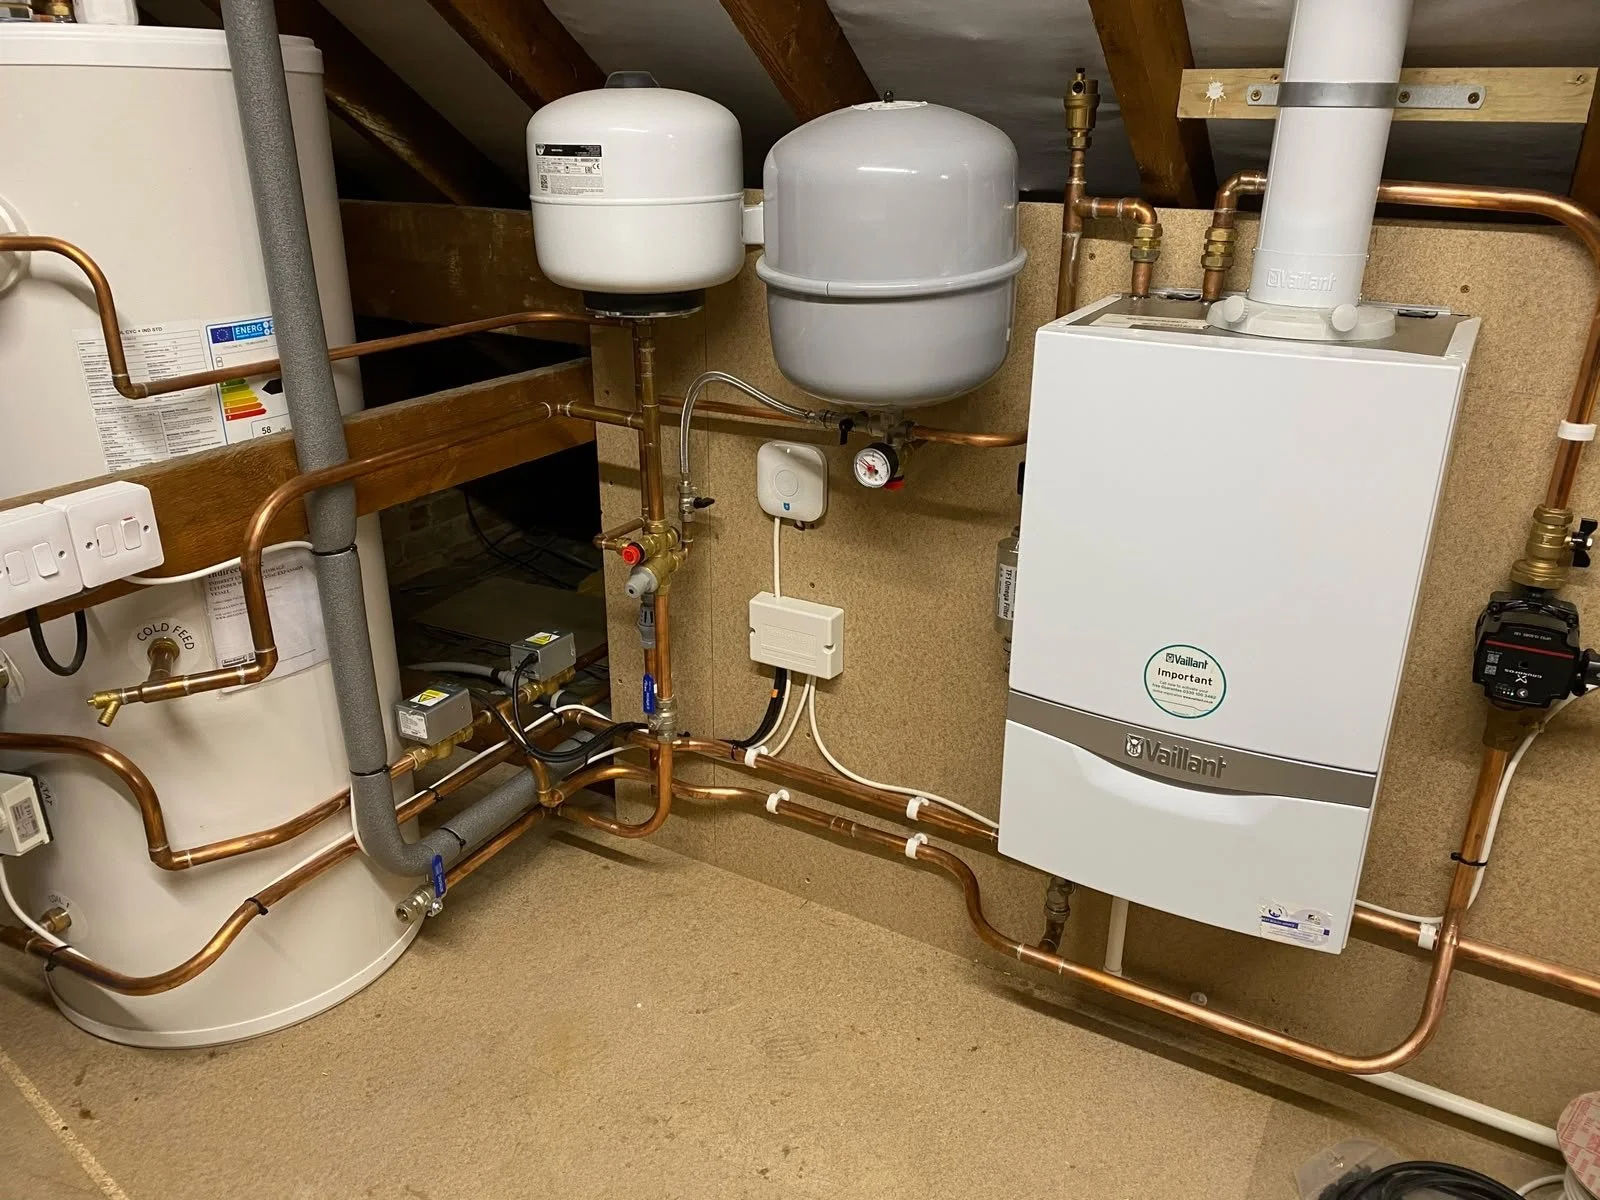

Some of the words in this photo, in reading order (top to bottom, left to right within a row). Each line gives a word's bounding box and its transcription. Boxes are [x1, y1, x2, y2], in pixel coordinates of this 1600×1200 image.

[1281, 270, 1337, 291] Vaillant
[235, 323, 263, 335] ENERG
[261, 425, 272, 435] 58
[1003, 581, 1011, 601] Omega
[137, 622, 170, 641] COLD
[172, 625, 195, 650] FEED
[1175, 654, 1208, 669] Vaillant
[1157, 667, 1213, 686] Important
[1504, 668, 1543, 679] GRUNDFOS
[1145, 738, 1227, 779] Vaillant
